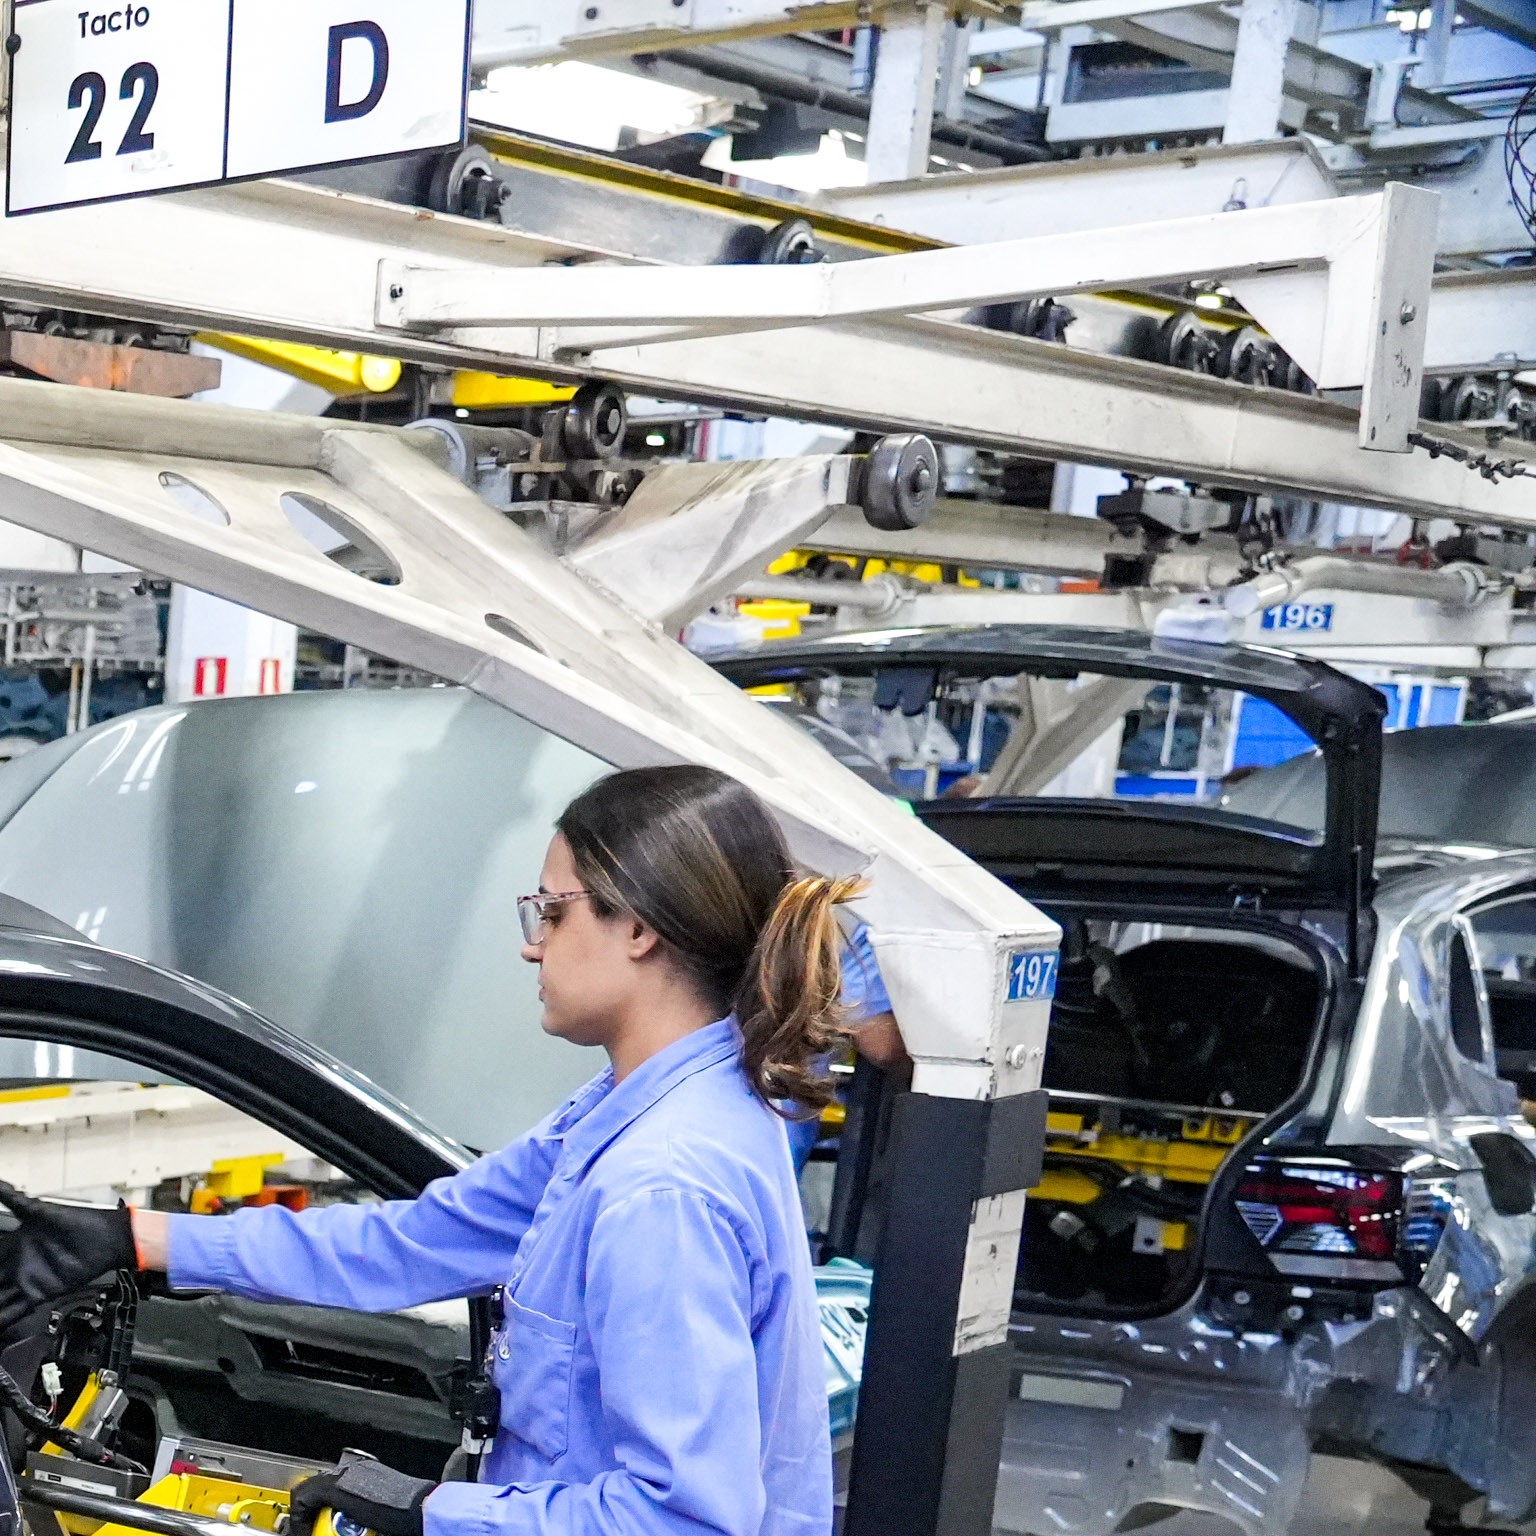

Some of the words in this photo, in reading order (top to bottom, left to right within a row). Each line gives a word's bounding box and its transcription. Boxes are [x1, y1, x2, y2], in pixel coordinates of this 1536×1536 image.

[78, 4, 150, 38] Tacto
[324, 20, 389, 124] D
[64, 61, 159, 165] 22
[1267, 604, 1327, 629] 196
[1014, 955, 1056, 998] 197
